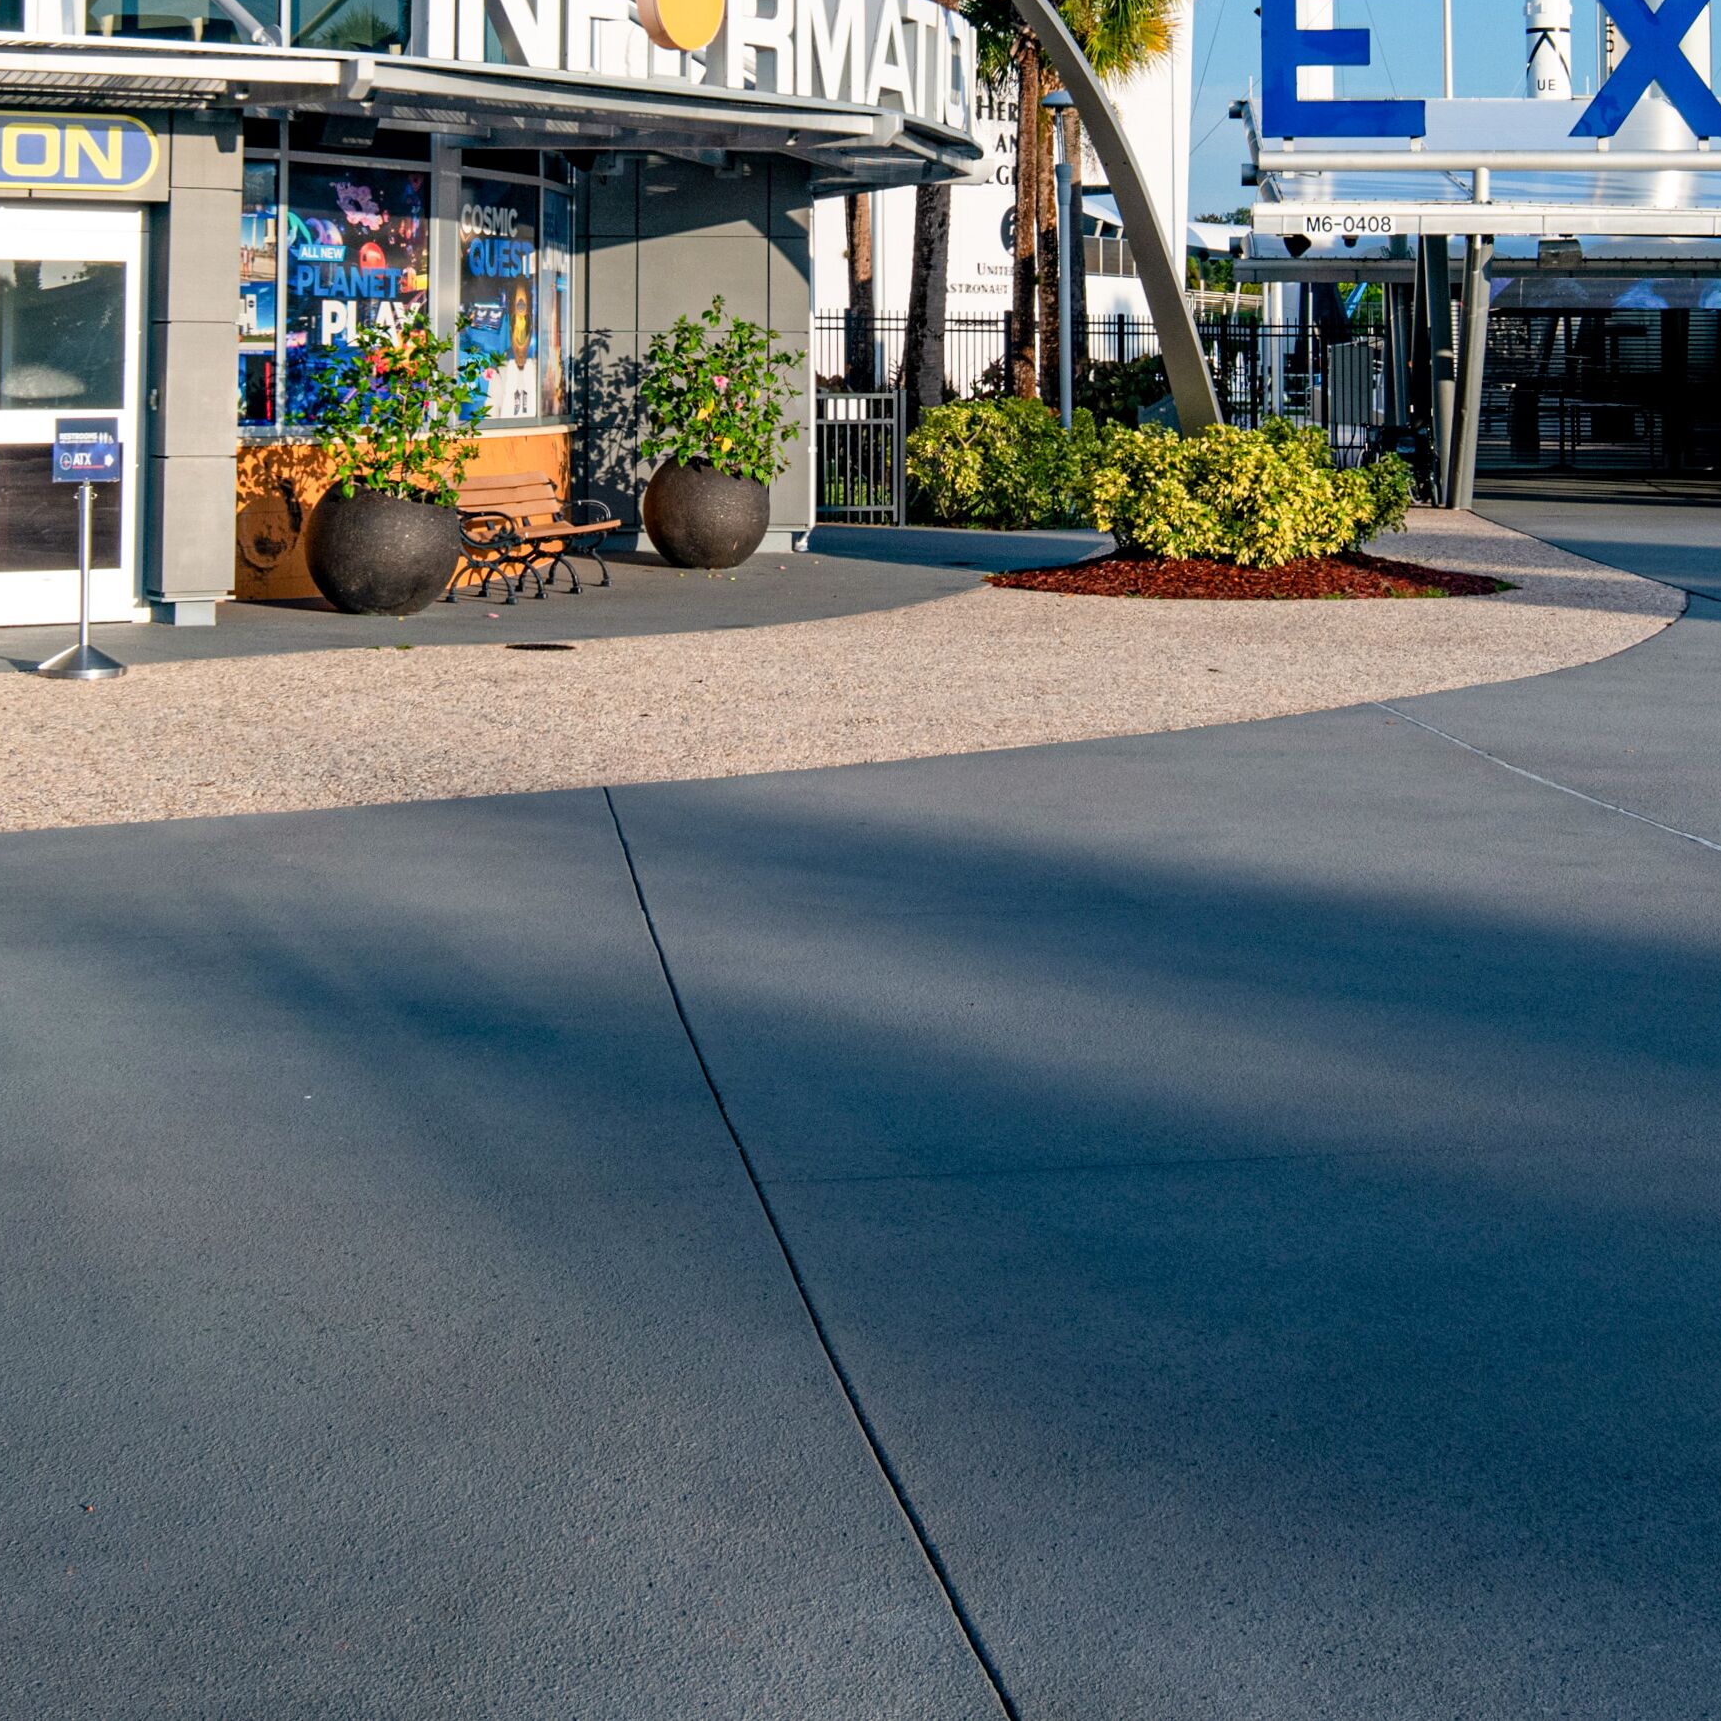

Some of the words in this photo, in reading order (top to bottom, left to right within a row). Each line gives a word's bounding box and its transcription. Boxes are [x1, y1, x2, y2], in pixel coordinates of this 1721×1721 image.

[461, 203, 518, 238] COSMIC
[1306, 216, 1392, 233] M6-0408
[301, 247, 318, 258] ALL
[321, 248, 344, 259] NEW
[469, 238, 535, 279] QUEST
[976, 262, 1014, 276] UNITE
[296, 265, 403, 298] PLANET
[948, 283, 1008, 294] STRONAUT
